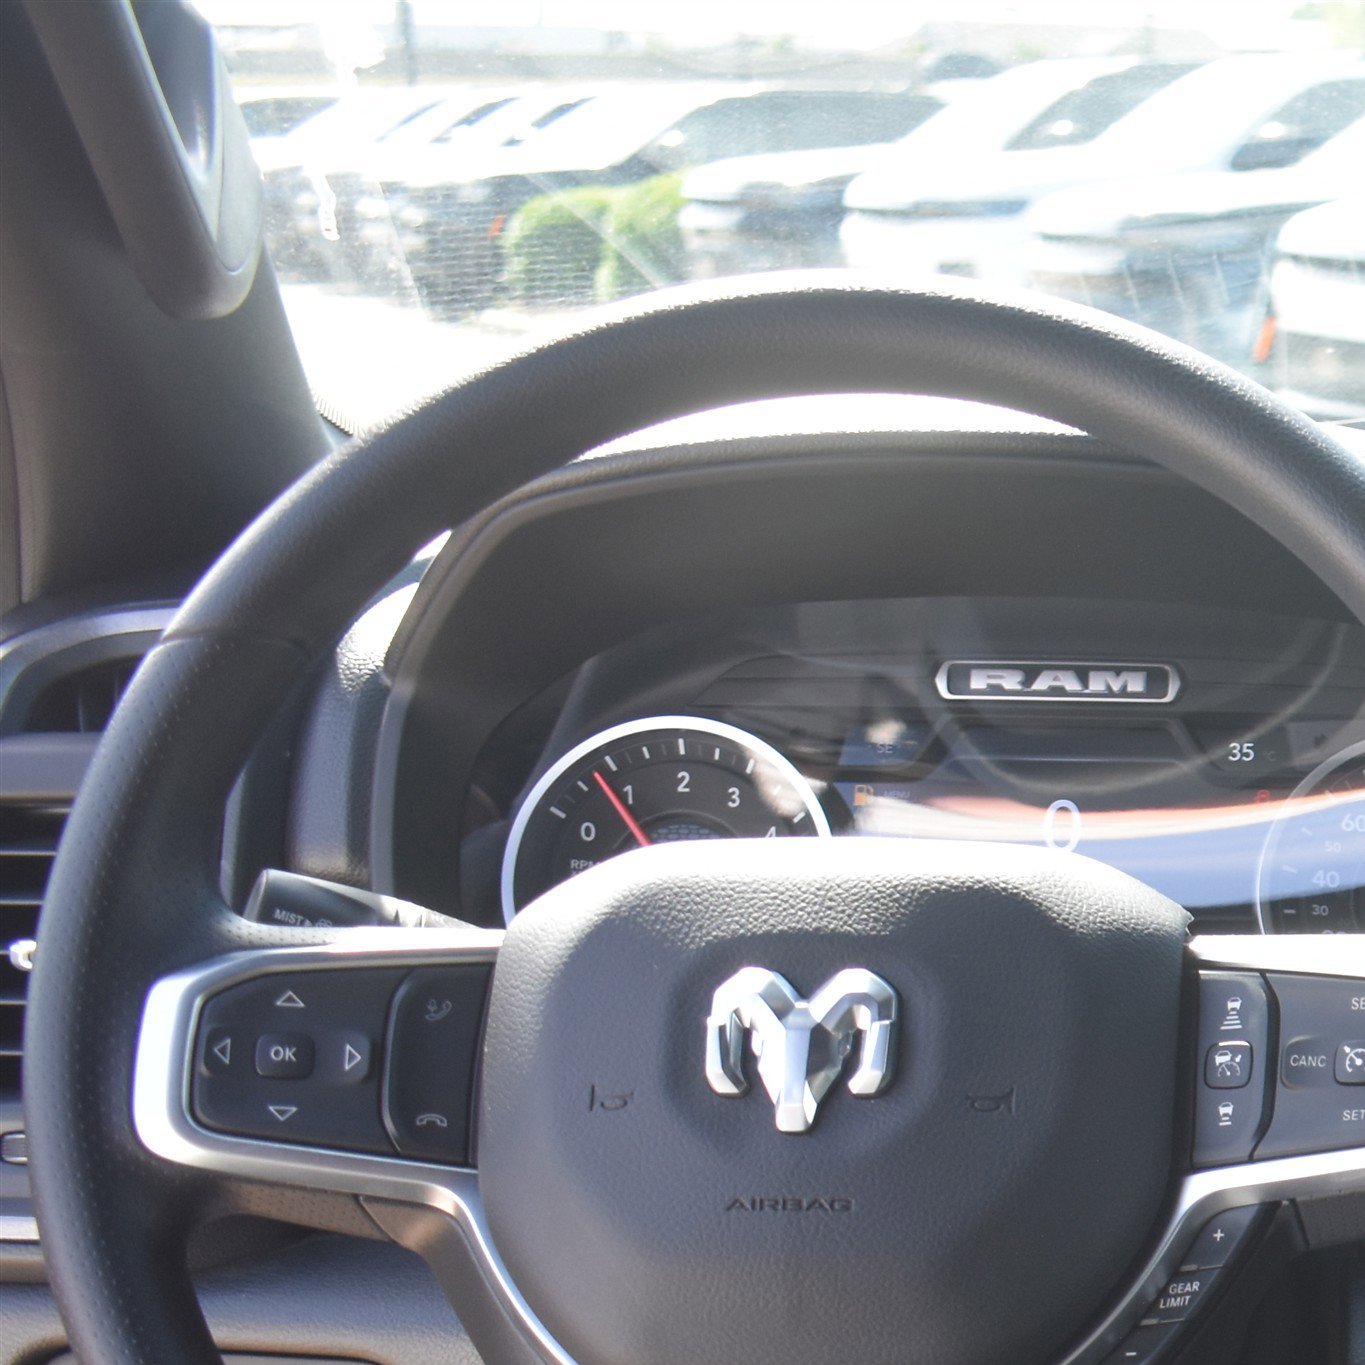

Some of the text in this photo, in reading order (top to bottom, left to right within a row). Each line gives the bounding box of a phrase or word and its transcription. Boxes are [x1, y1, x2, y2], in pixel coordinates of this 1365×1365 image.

[969, 668, 1148, 694] RAM
[1228, 743, 1255, 762] 35
[677, 771, 691, 793] 2
[623, 785, 633, 805] 1
[727, 787, 741, 808] 3
[581, 822, 596, 842] 0
[1044, 799, 1082, 853] 0
[1312, 870, 1340, 888] 40
[274, 908, 304, 927] MIST
[1312, 905, 1329, 916] 30
[270, 1046, 296, 1062] OK
[1289, 1054, 1327, 1068] CANC
[725, 1198, 856, 1213] AIRBAG
[1168, 1281, 1200, 1294] GEAR
[1159, 1295, 1191, 1309] LIMIT
